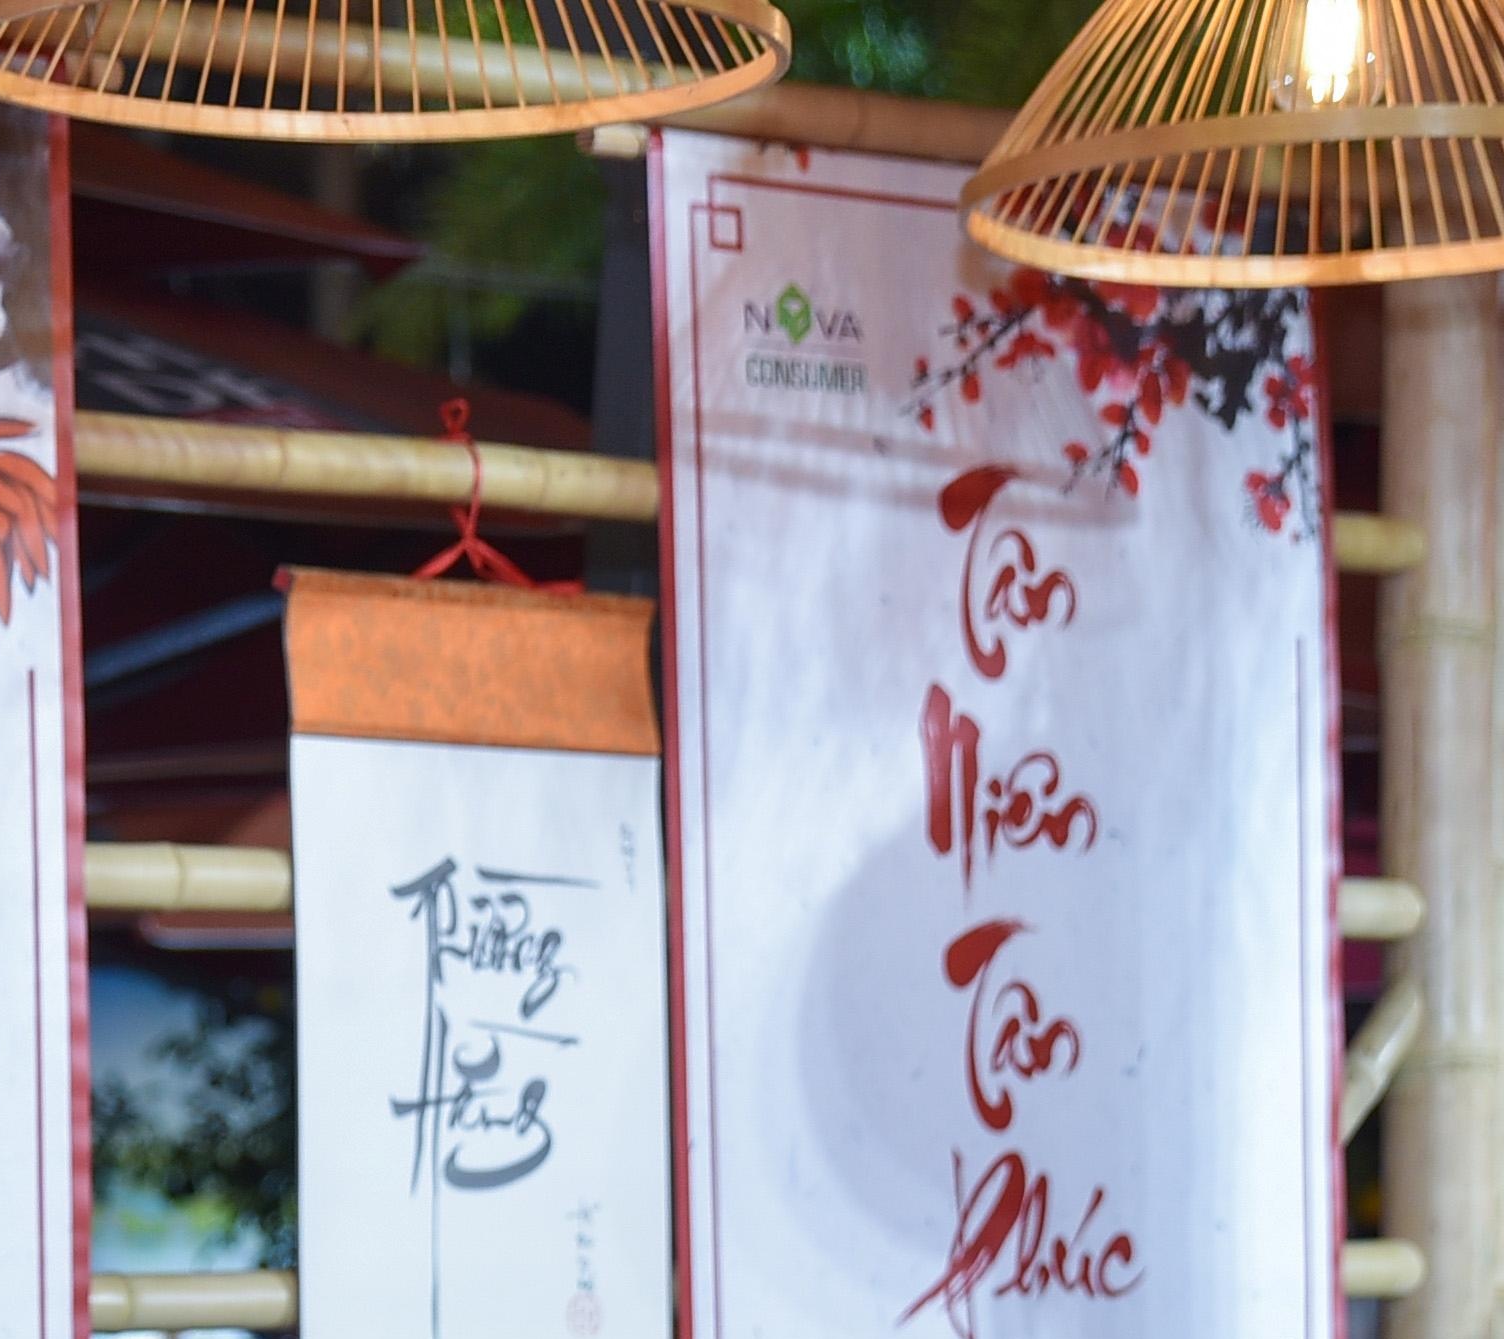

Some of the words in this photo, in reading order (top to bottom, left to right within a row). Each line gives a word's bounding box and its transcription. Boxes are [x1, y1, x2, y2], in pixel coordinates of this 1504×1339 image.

[744, 282, 863, 344] NOVA
[745, 353, 867, 394] CONSUMER
[938, 463, 1078, 680] Tân
[919, 682, 1098, 900] Niên
[942, 916, 1081, 1134] Tân
